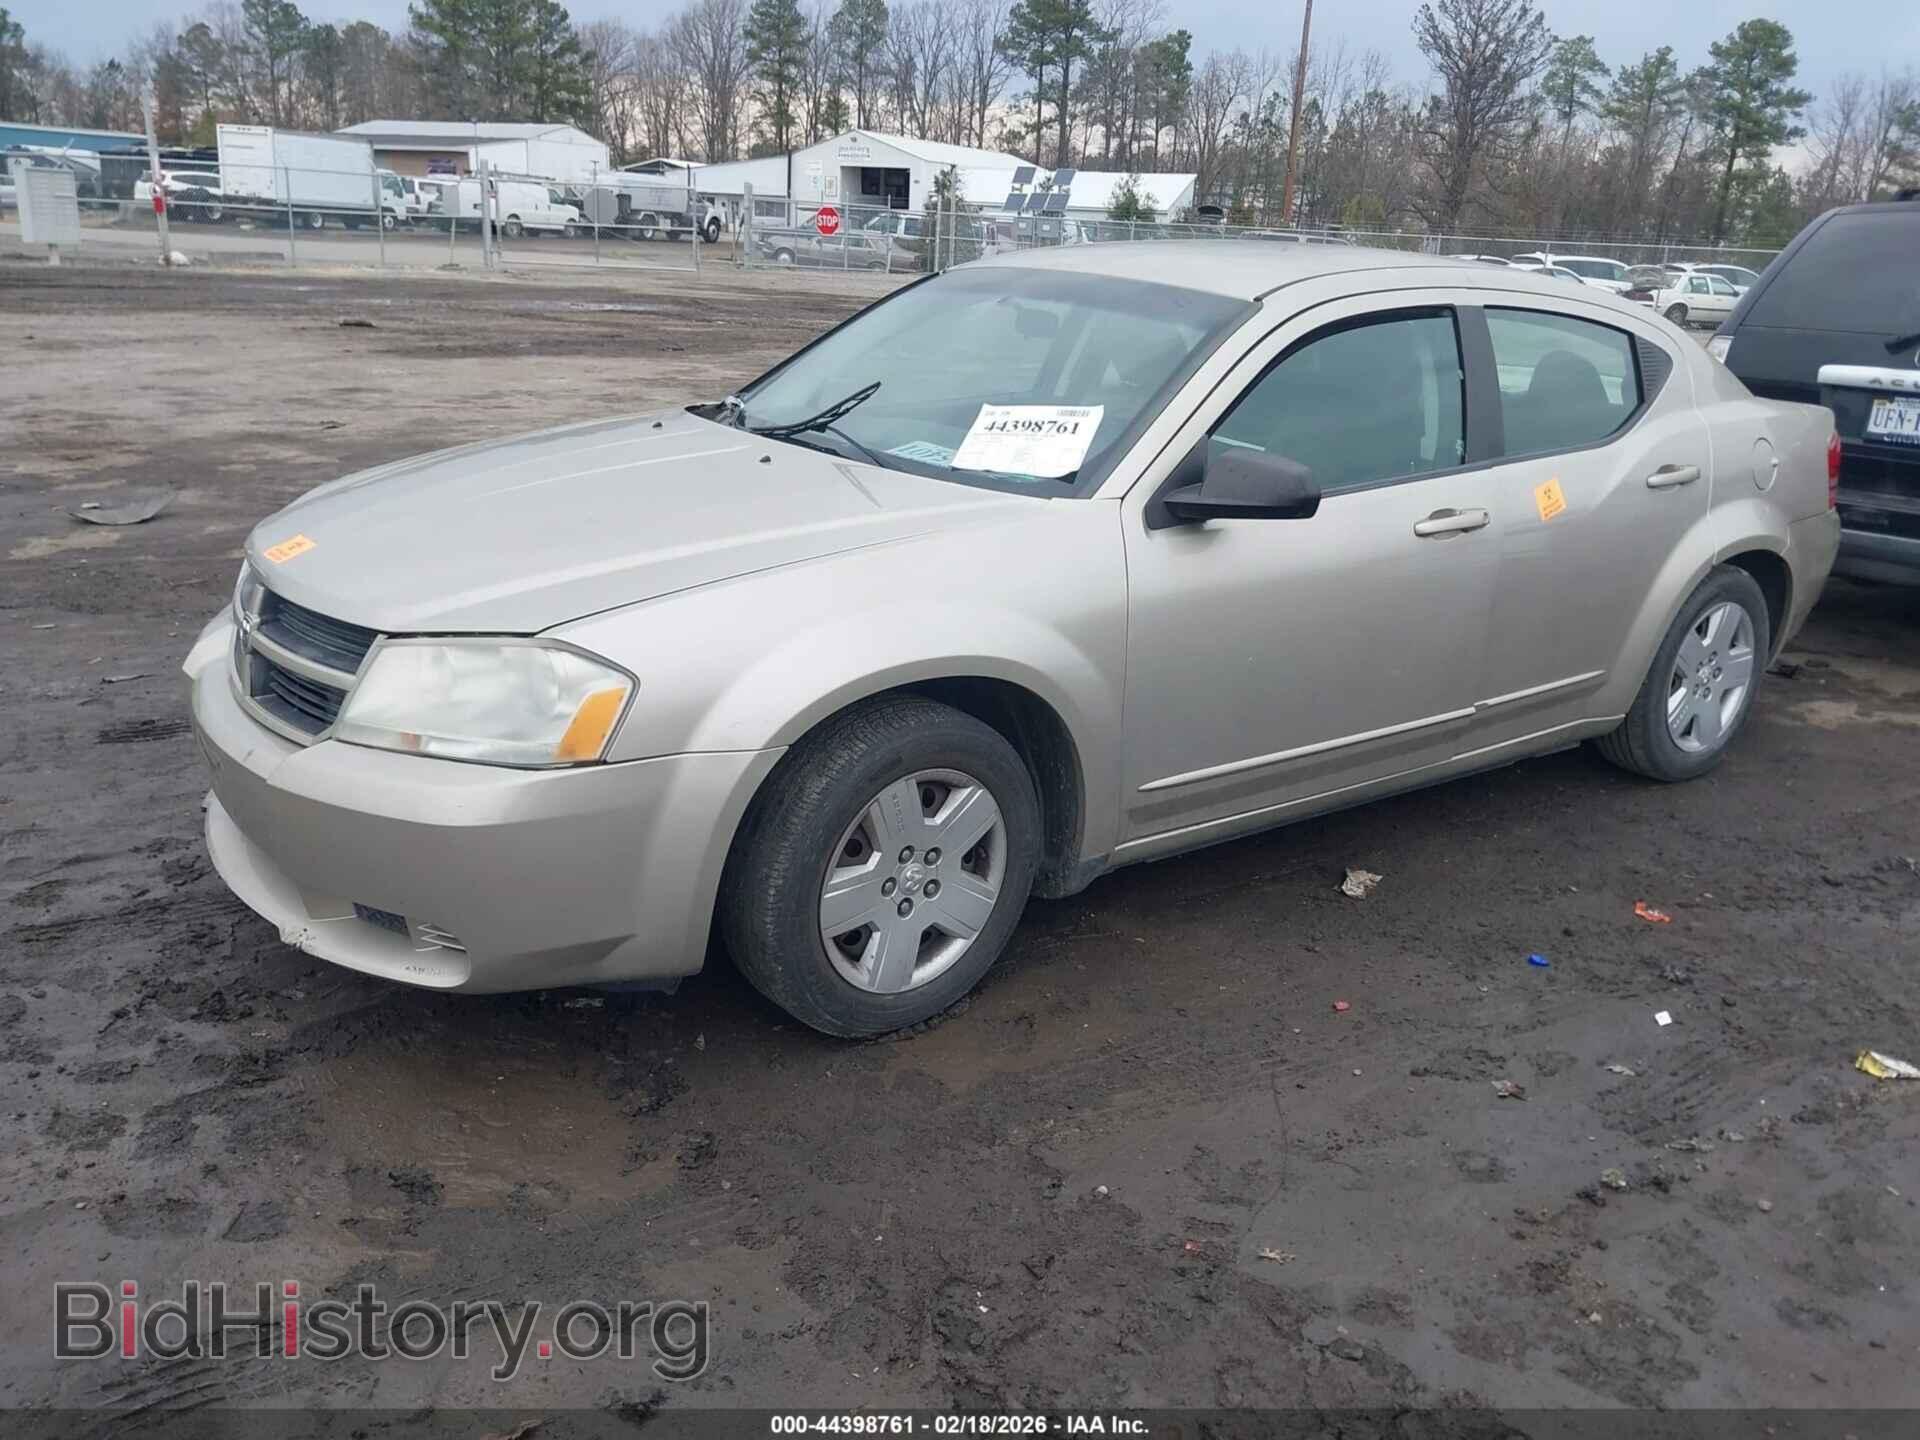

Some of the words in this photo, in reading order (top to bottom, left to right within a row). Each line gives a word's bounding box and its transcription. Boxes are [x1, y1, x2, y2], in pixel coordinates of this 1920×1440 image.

[817, 214, 838, 227] STOP
[1873, 407, 1920, 430] UFN-
[984, 420, 1080, 435] 44398761
